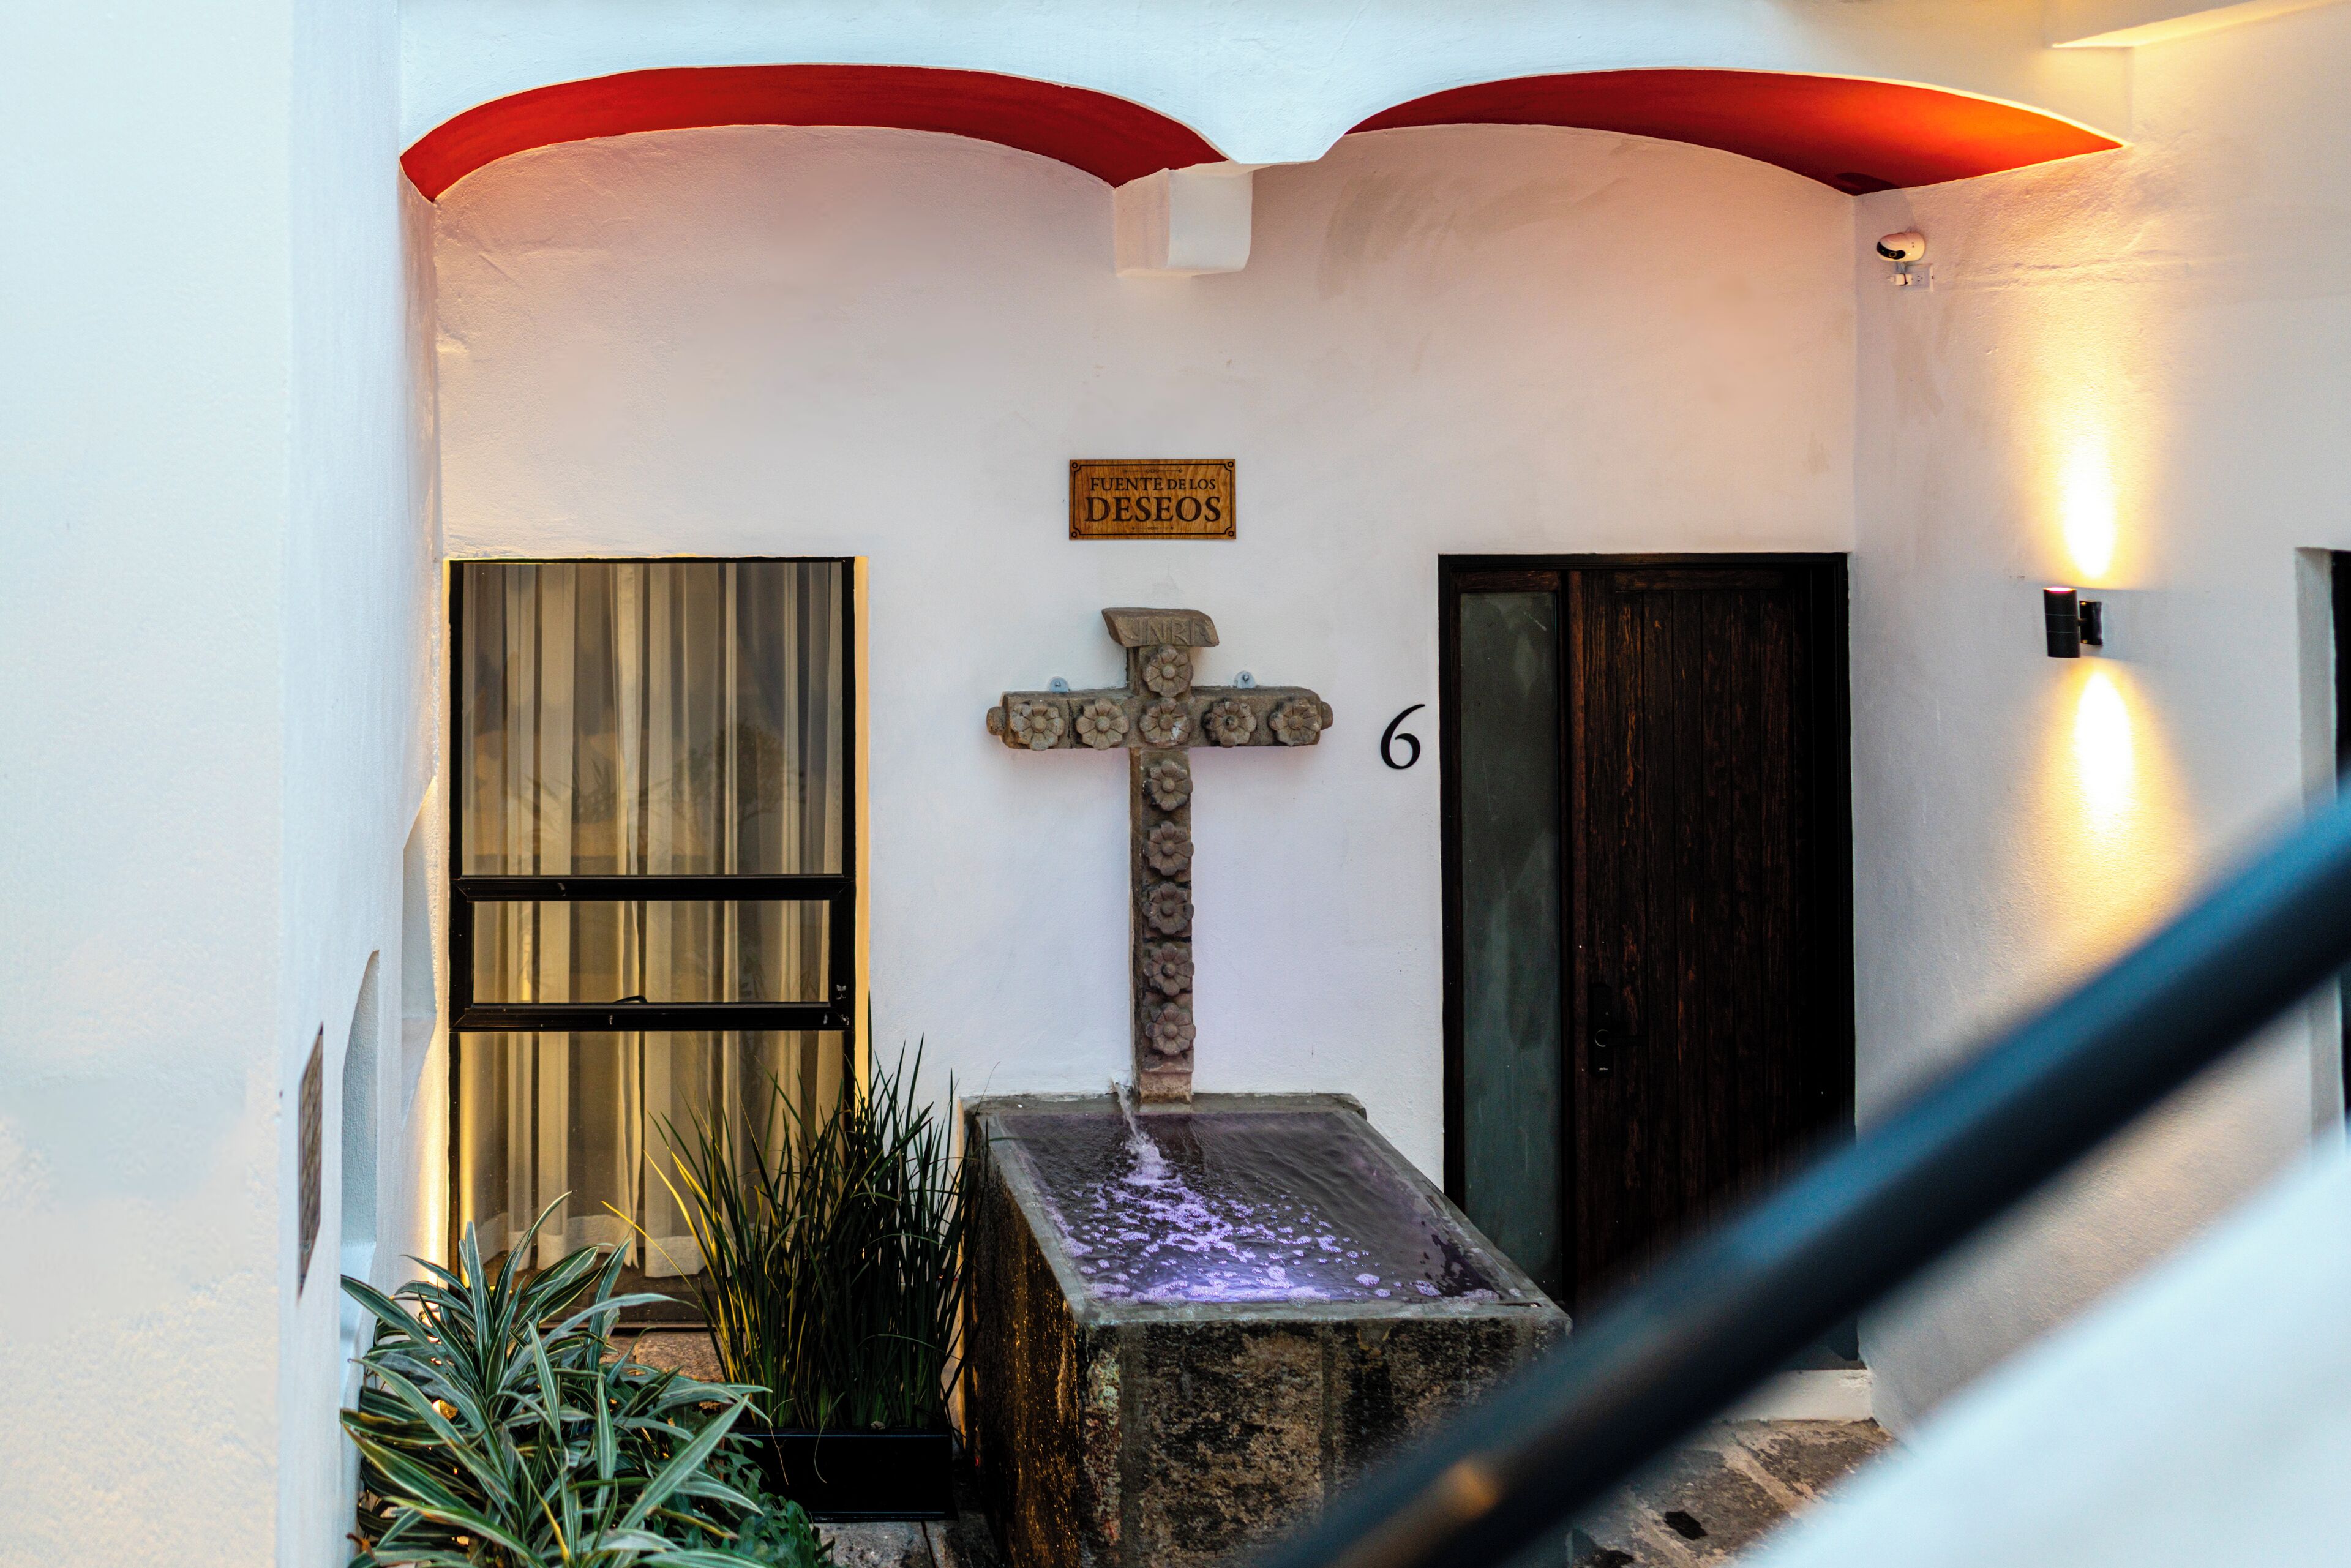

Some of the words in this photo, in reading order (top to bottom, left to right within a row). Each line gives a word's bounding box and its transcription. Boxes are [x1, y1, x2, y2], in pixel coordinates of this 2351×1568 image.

[1090, 477, 1162, 491] FUENTE
[1167, 479, 1187, 490] DE
[1190, 478, 1216, 490] LOS
[1084, 496, 1221, 522] DESEOS
[1380, 703, 1426, 770] 6
